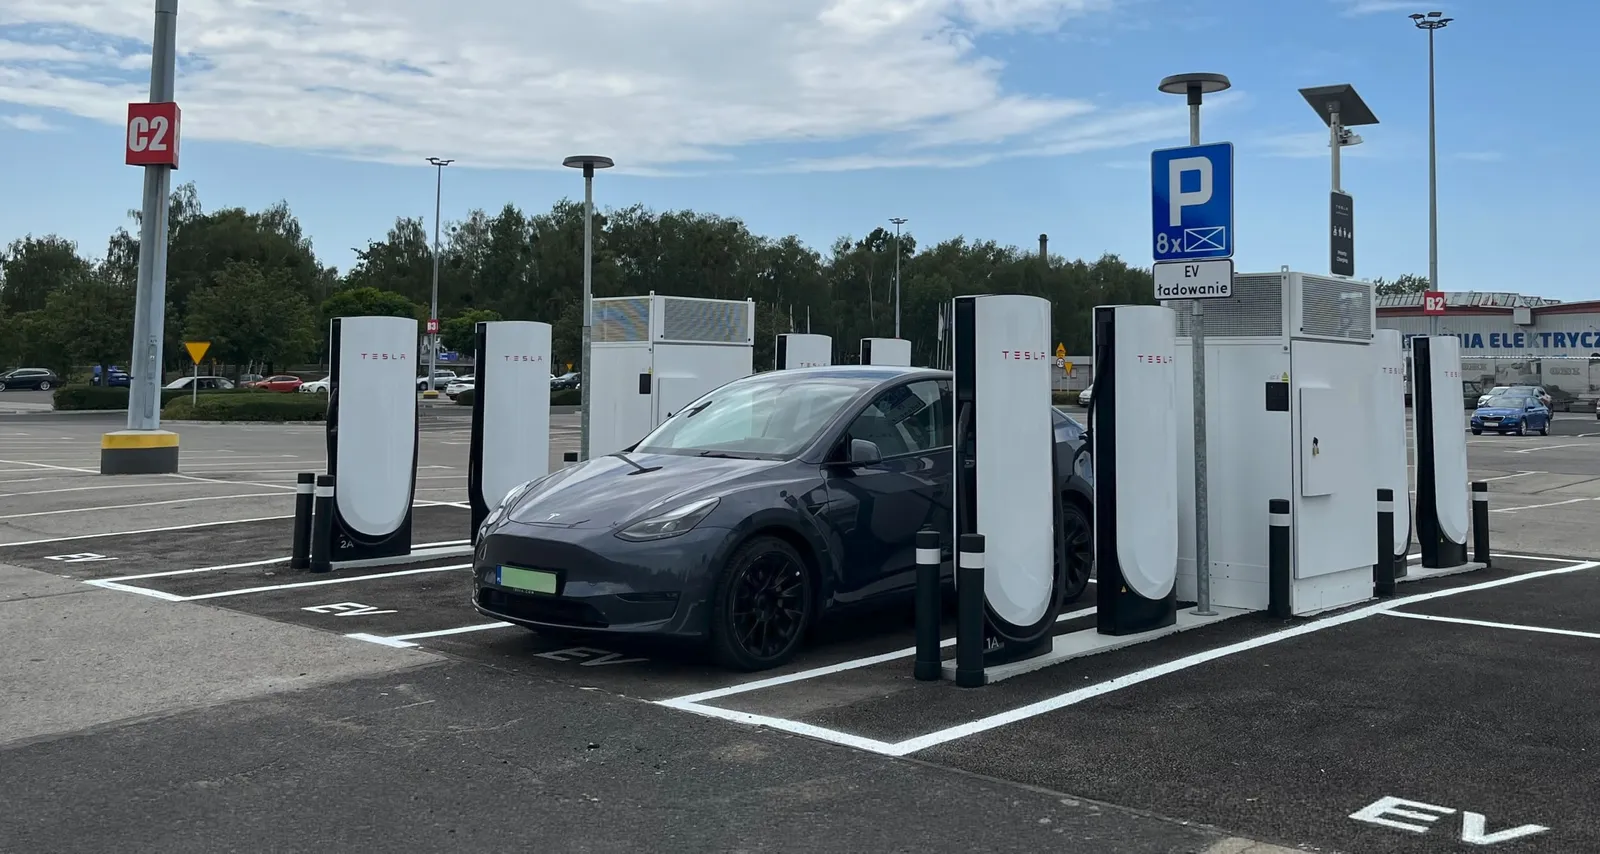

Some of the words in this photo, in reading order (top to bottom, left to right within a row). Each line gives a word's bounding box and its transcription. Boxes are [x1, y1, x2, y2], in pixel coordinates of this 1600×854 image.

[128, 115, 169, 152] C2
[1168, 156, 1213, 227] P
[1184, 265, 1199, 278] EV
[1157, 281, 1228, 296] ładowanie
[1426, 296, 1444, 311] B2
[1002, 351, 1046, 360] TESLA
[1137, 355, 1173, 364] TESLA
[340, 540, 355, 549] 2A
[43, 553, 119, 563] EV
[300, 602, 399, 616] EV
[986, 636, 1000, 649] 1A
[532, 647, 650, 667] EV
[1348, 796, 1551, 845] EV
